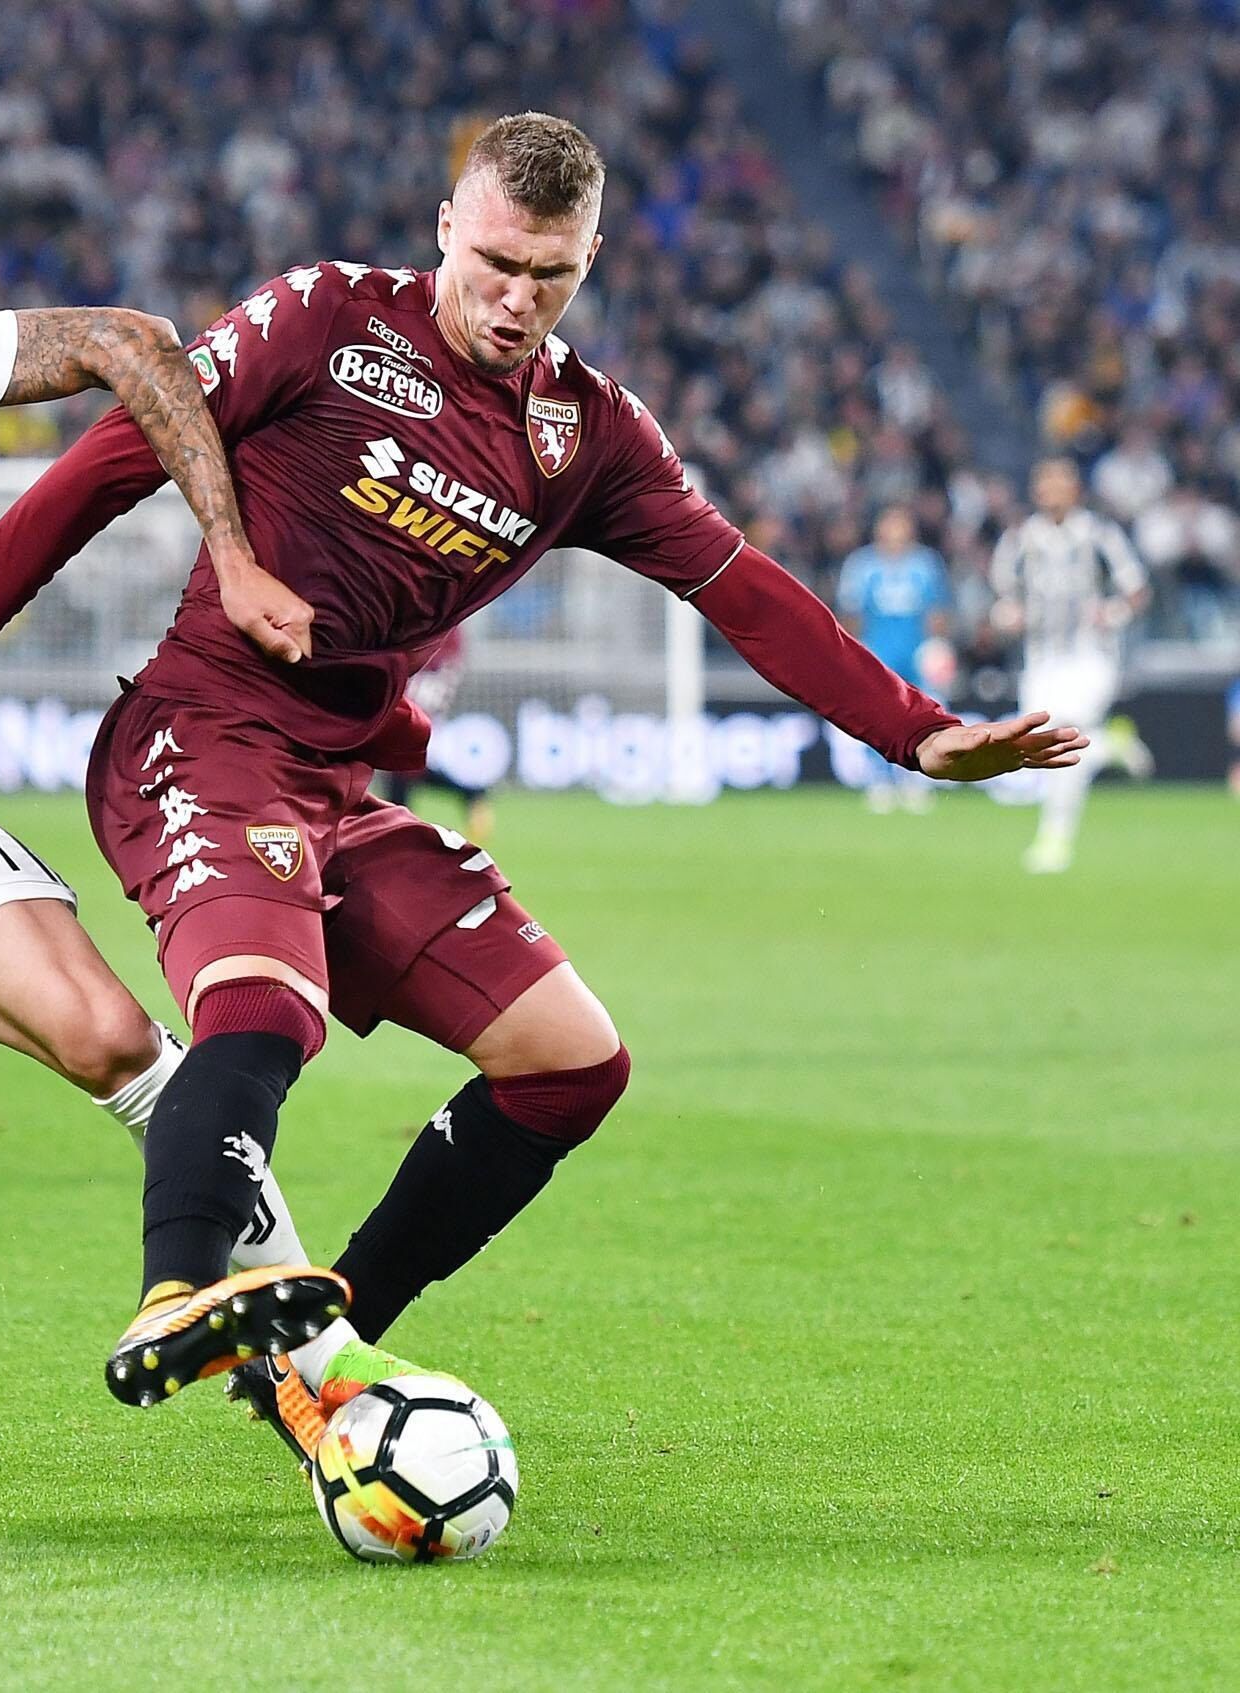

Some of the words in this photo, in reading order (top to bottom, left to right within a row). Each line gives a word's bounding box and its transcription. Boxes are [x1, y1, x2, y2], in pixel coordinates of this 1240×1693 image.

[336, 349, 438, 415] Beretta
[531, 401, 574, 420] TORINO
[556, 423, 575, 437] FC
[340, 478, 510, 574] SWIFT
[408, 461, 538, 547] SUZUKI
[517, 694, 821, 806] bigger
[253, 831, 295, 840] TORINO
